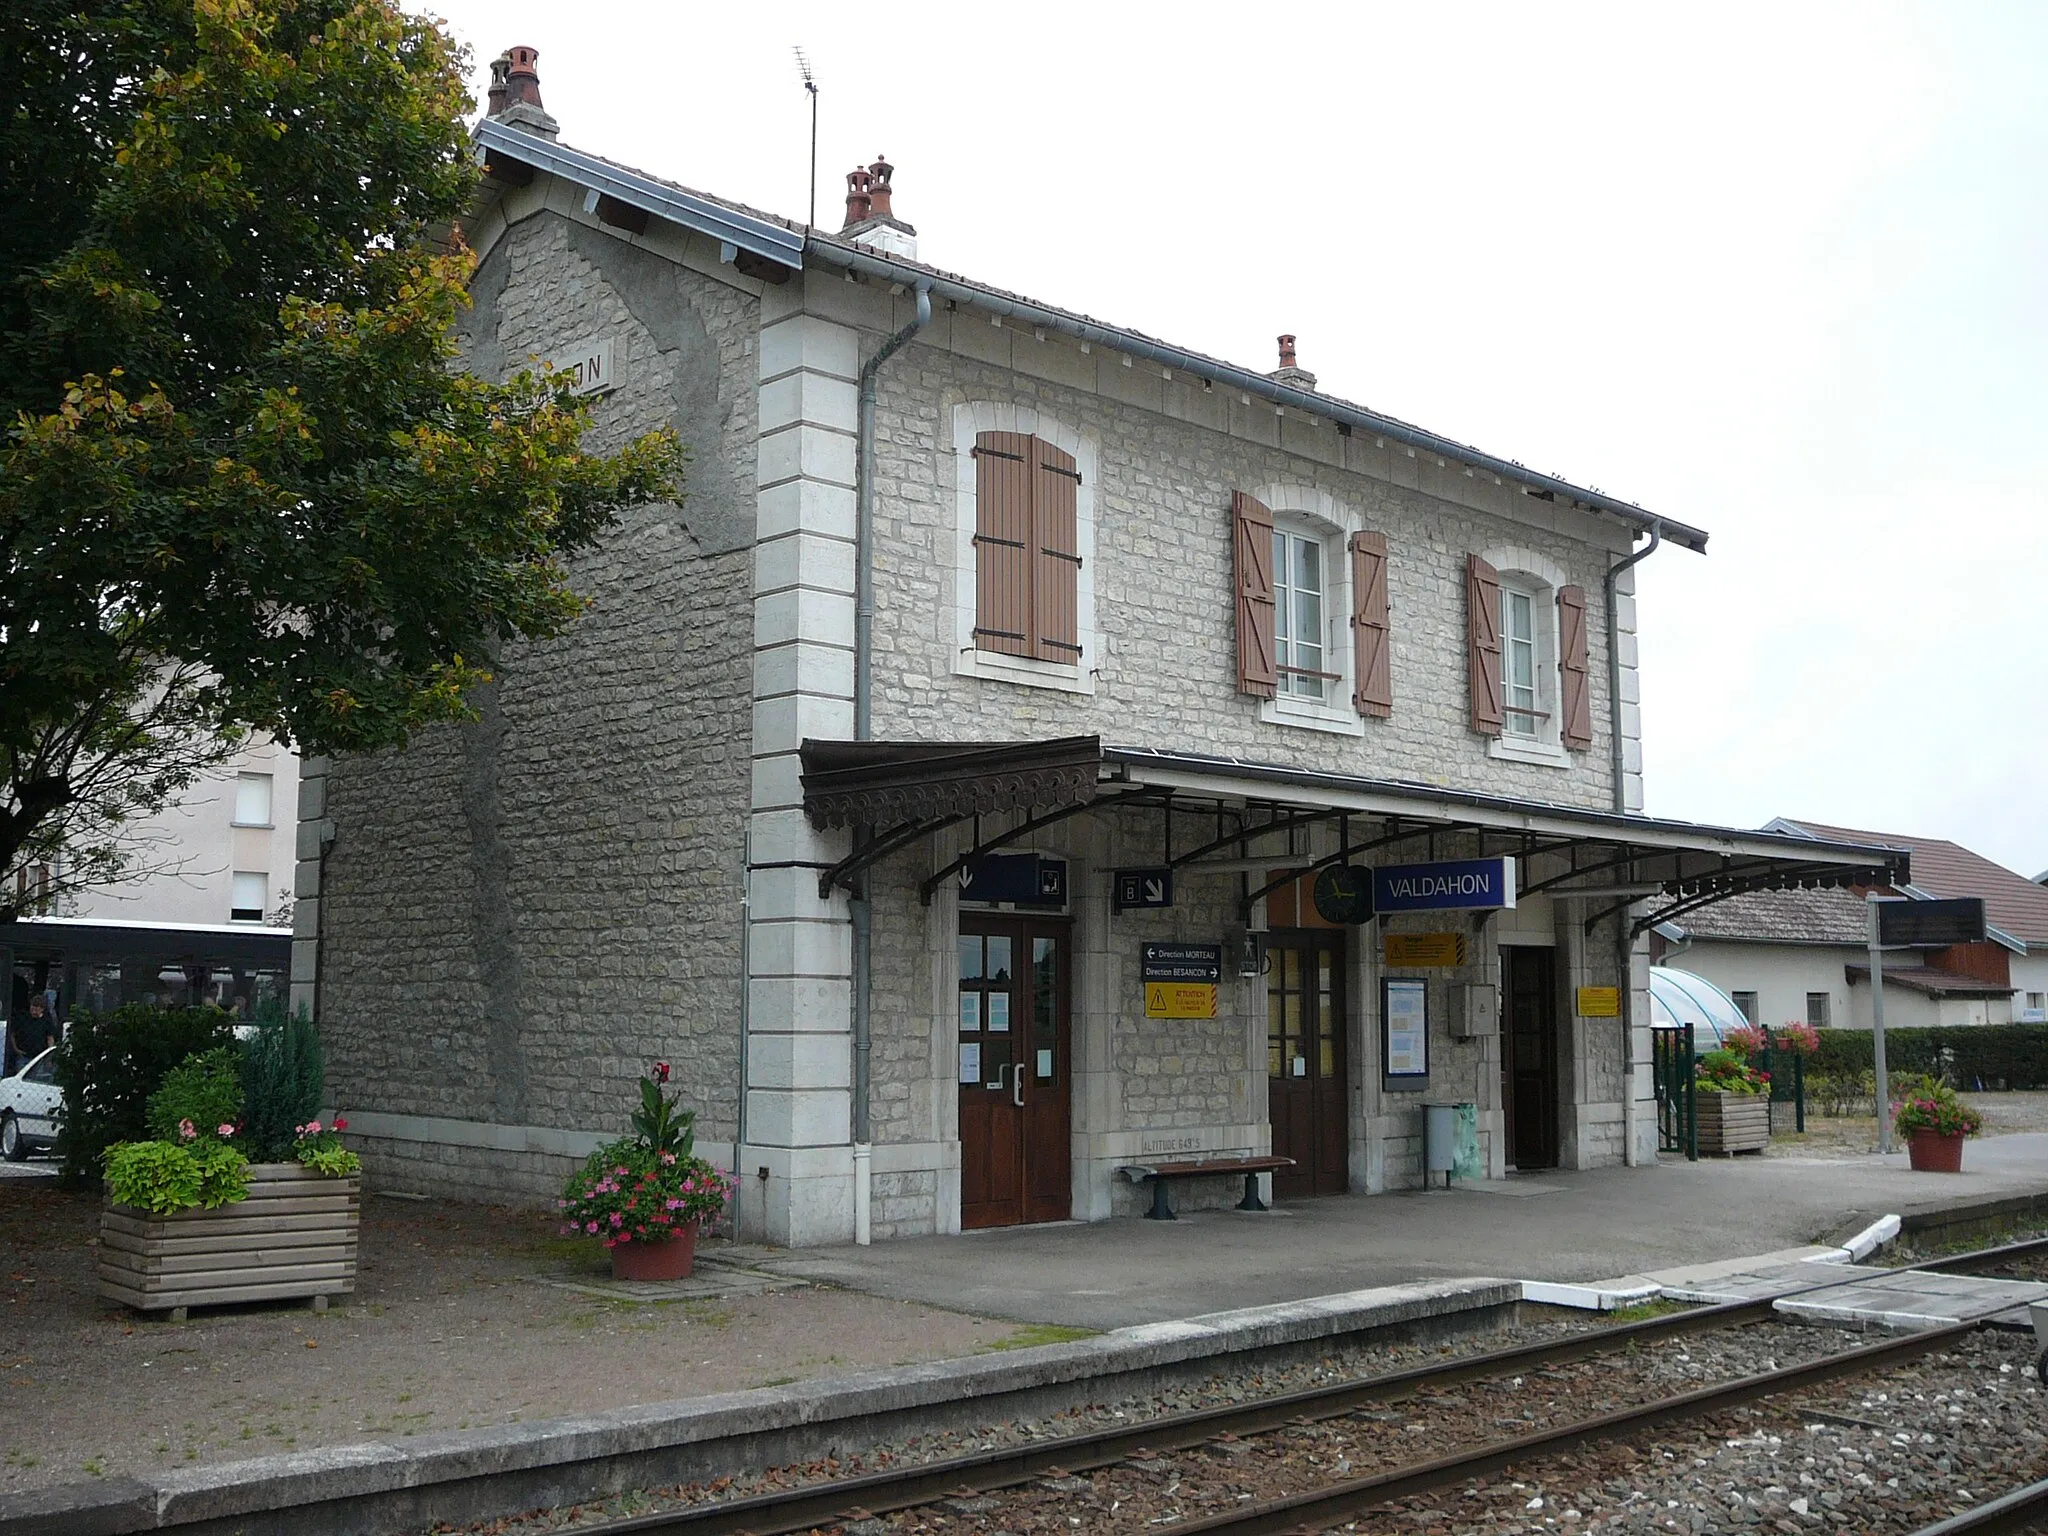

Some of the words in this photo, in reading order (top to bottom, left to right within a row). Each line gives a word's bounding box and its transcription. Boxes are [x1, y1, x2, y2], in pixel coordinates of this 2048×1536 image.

[1388, 873, 1489, 898] VALDAHON
[1126, 886, 1135, 900] B
[1158, 949, 1184, 959] Direction
[1185, 950, 1216, 960] MORTEAU
[1145, 967, 1172, 977] Direction
[1176, 990, 1206, 998] ATTENTION
[1144, 1139, 1176, 1152] ALTITUDE
